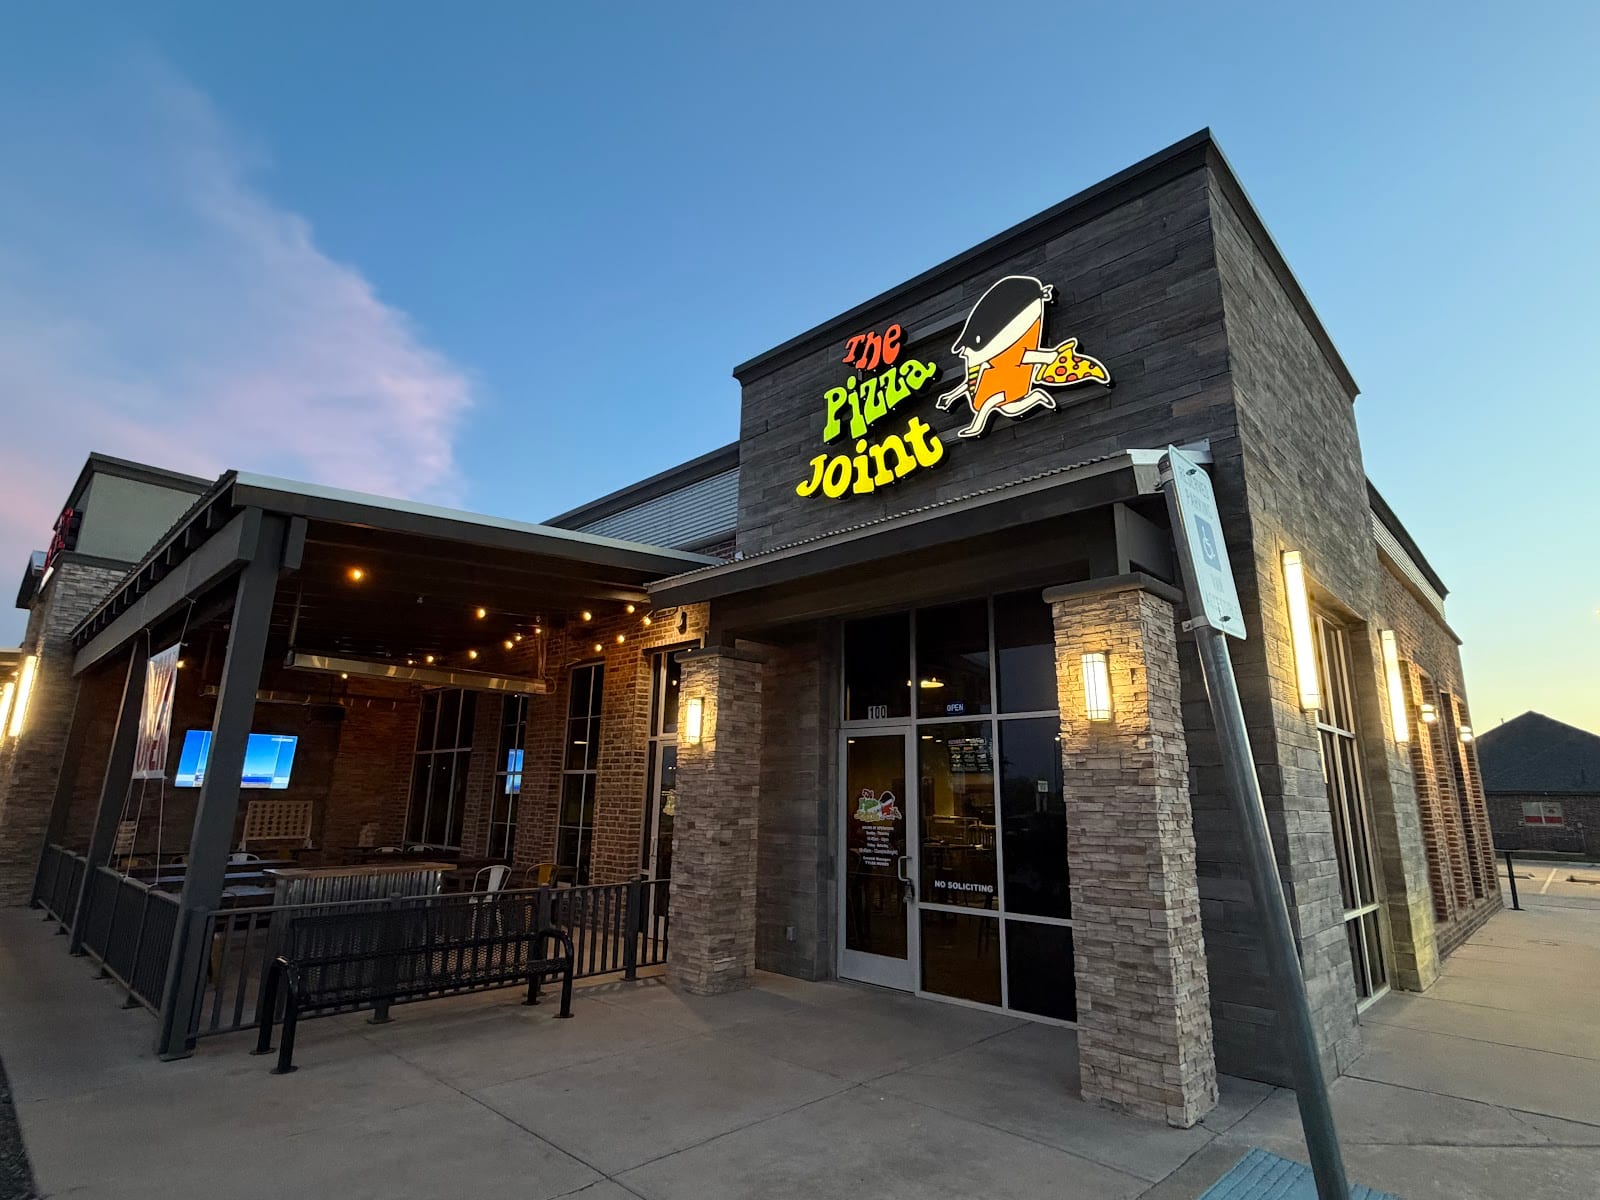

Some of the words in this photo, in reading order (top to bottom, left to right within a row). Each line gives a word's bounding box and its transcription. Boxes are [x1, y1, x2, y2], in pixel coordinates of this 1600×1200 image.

[843, 324, 901, 370] The
[823, 359, 937, 443] Pizza
[796, 416, 944, 498] Joint
[869, 705, 888, 719] 100
[946, 703, 964, 712] OPEN
[934, 880, 946, 888] NO
[947, 881, 994, 893] SOLICITING
